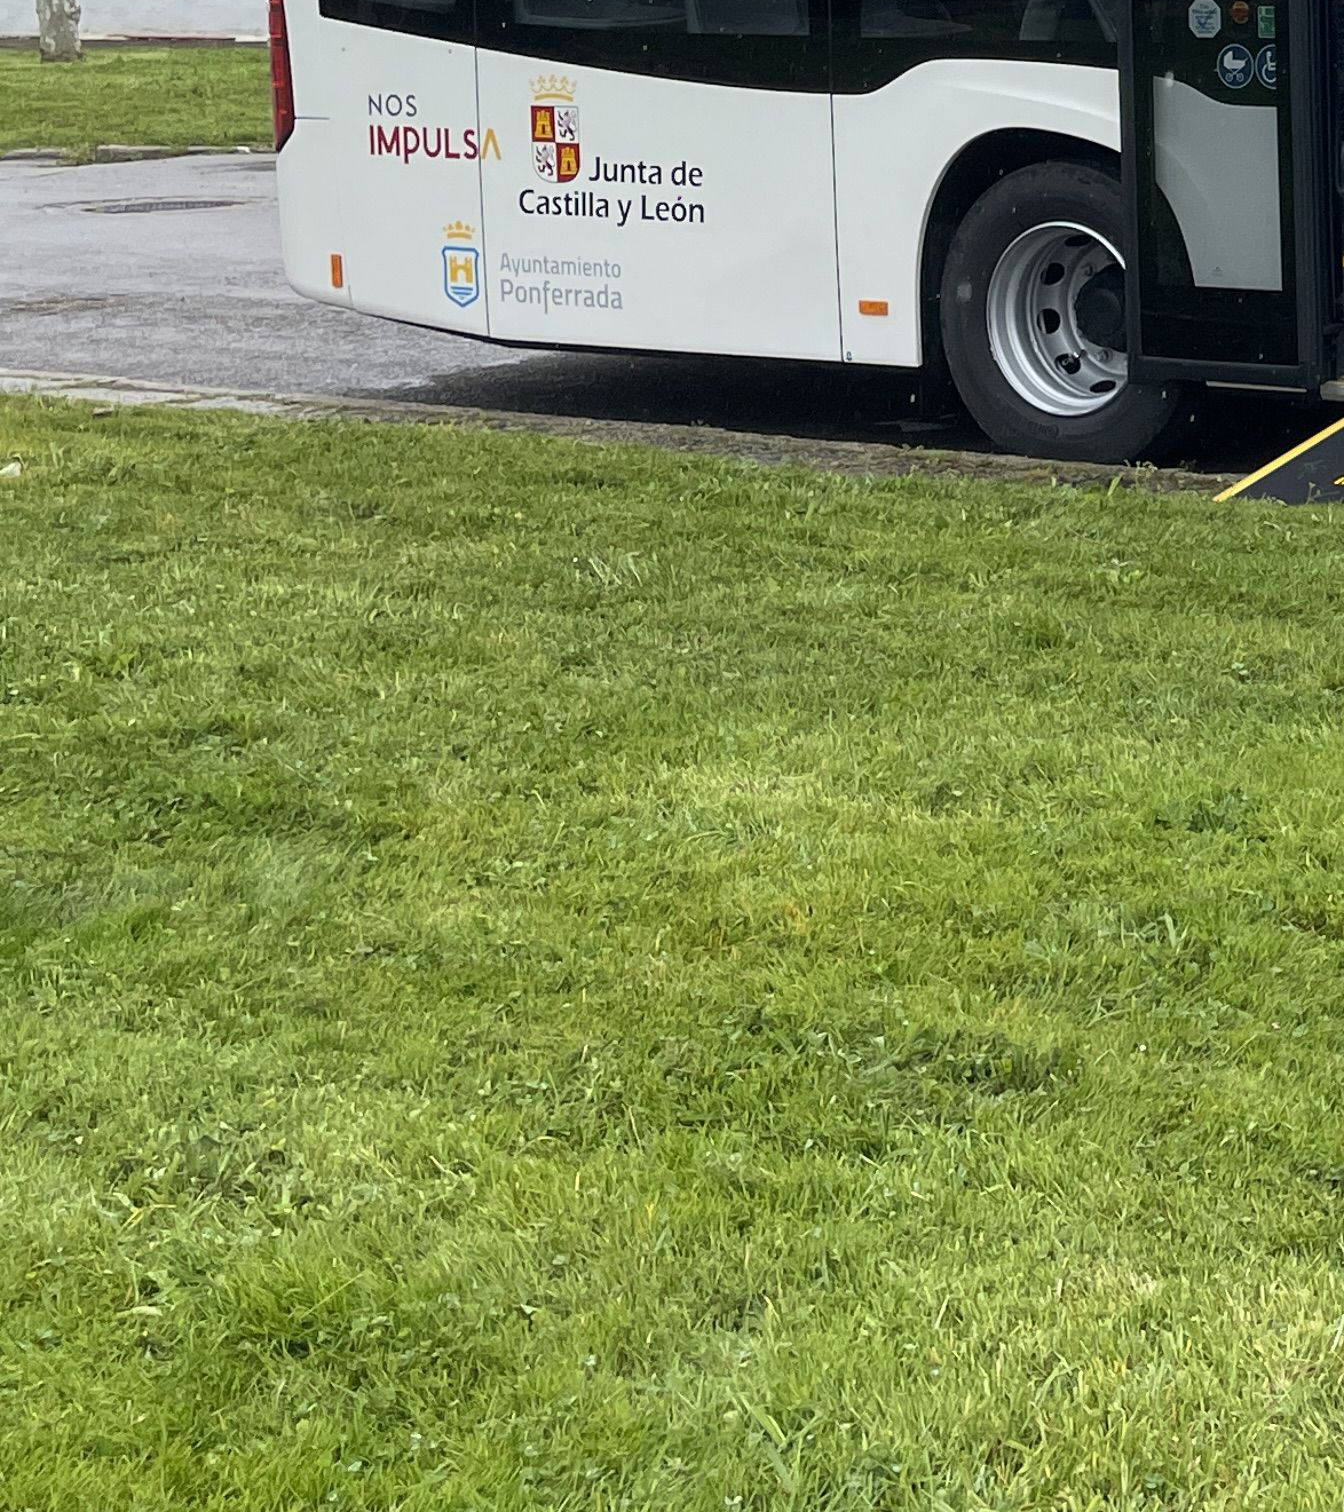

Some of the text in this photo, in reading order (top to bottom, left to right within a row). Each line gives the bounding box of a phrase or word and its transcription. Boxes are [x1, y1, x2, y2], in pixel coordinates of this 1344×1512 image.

[368, 93, 417, 117] NOS
[588, 156, 703, 187] Junta de
[519, 189, 705, 227] Castilla y León
[500, 252, 621, 279] Ayuntamiento
[500, 278, 623, 315] Ponferrada
